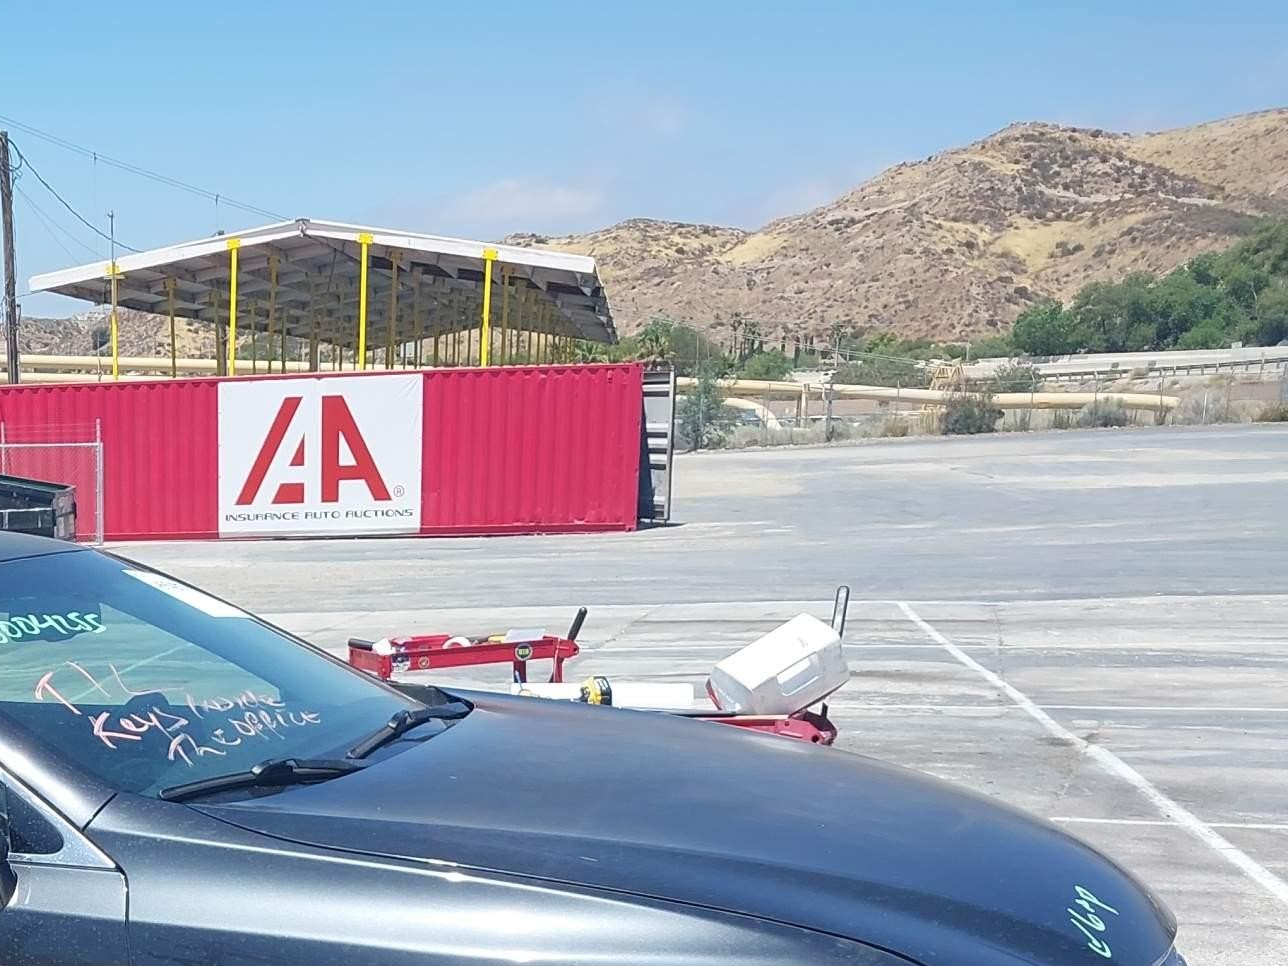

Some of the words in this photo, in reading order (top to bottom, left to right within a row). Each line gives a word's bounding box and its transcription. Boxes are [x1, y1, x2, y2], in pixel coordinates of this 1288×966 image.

[225, 511, 300, 522] INSURANCE
[304, 510, 341, 520] AUTO
[345, 508, 414, 519] AUCTIONS
